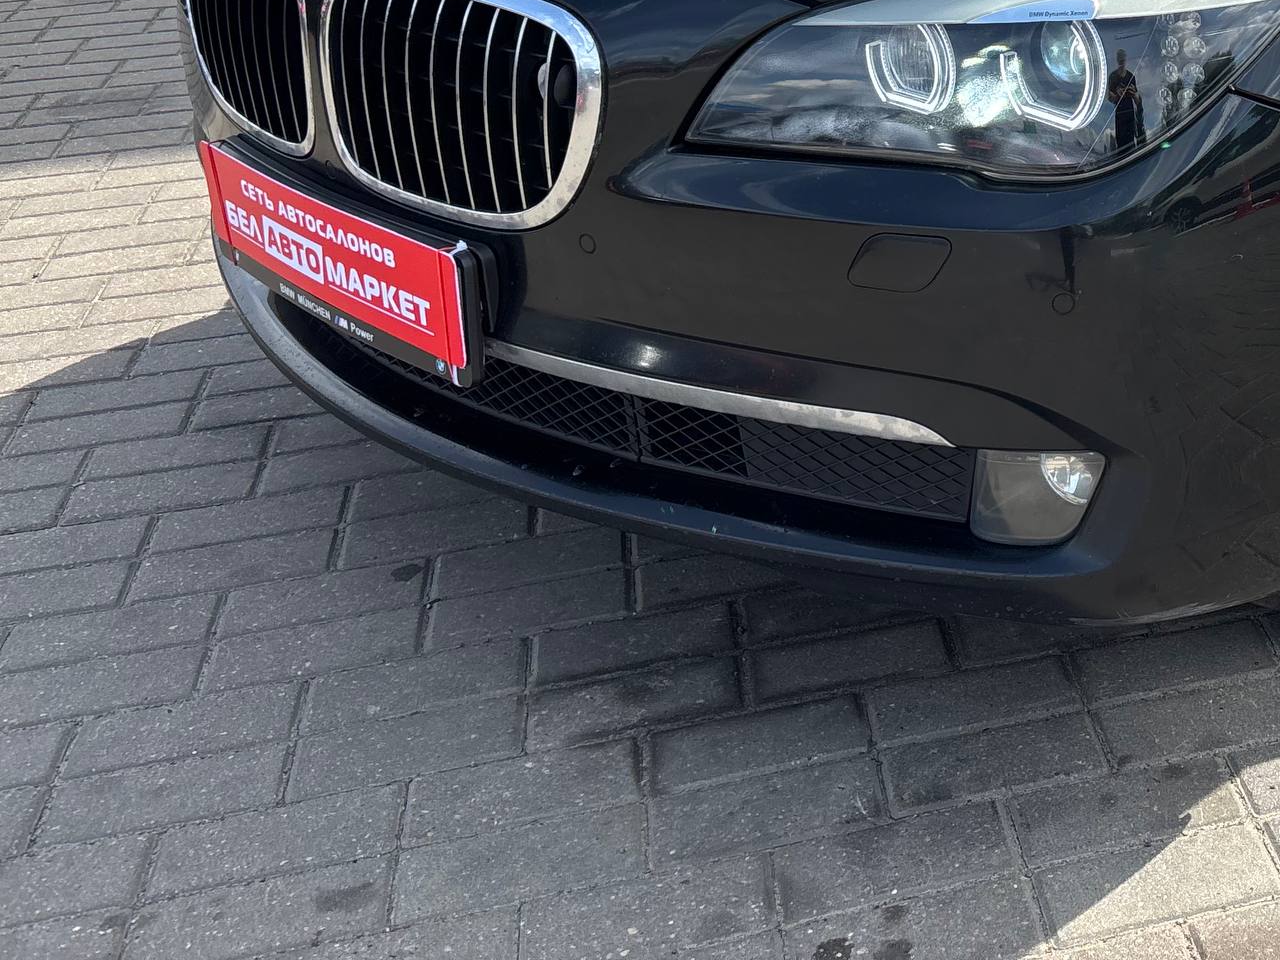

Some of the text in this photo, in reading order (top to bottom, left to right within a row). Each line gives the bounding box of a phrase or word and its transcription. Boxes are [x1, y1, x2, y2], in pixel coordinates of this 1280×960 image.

[1044, 10, 1070, 18] Dynamic
[240, 179, 396, 269] СЕТЬ АВТОСАЛОНОВ
[350, 322, 375, 342] Power
